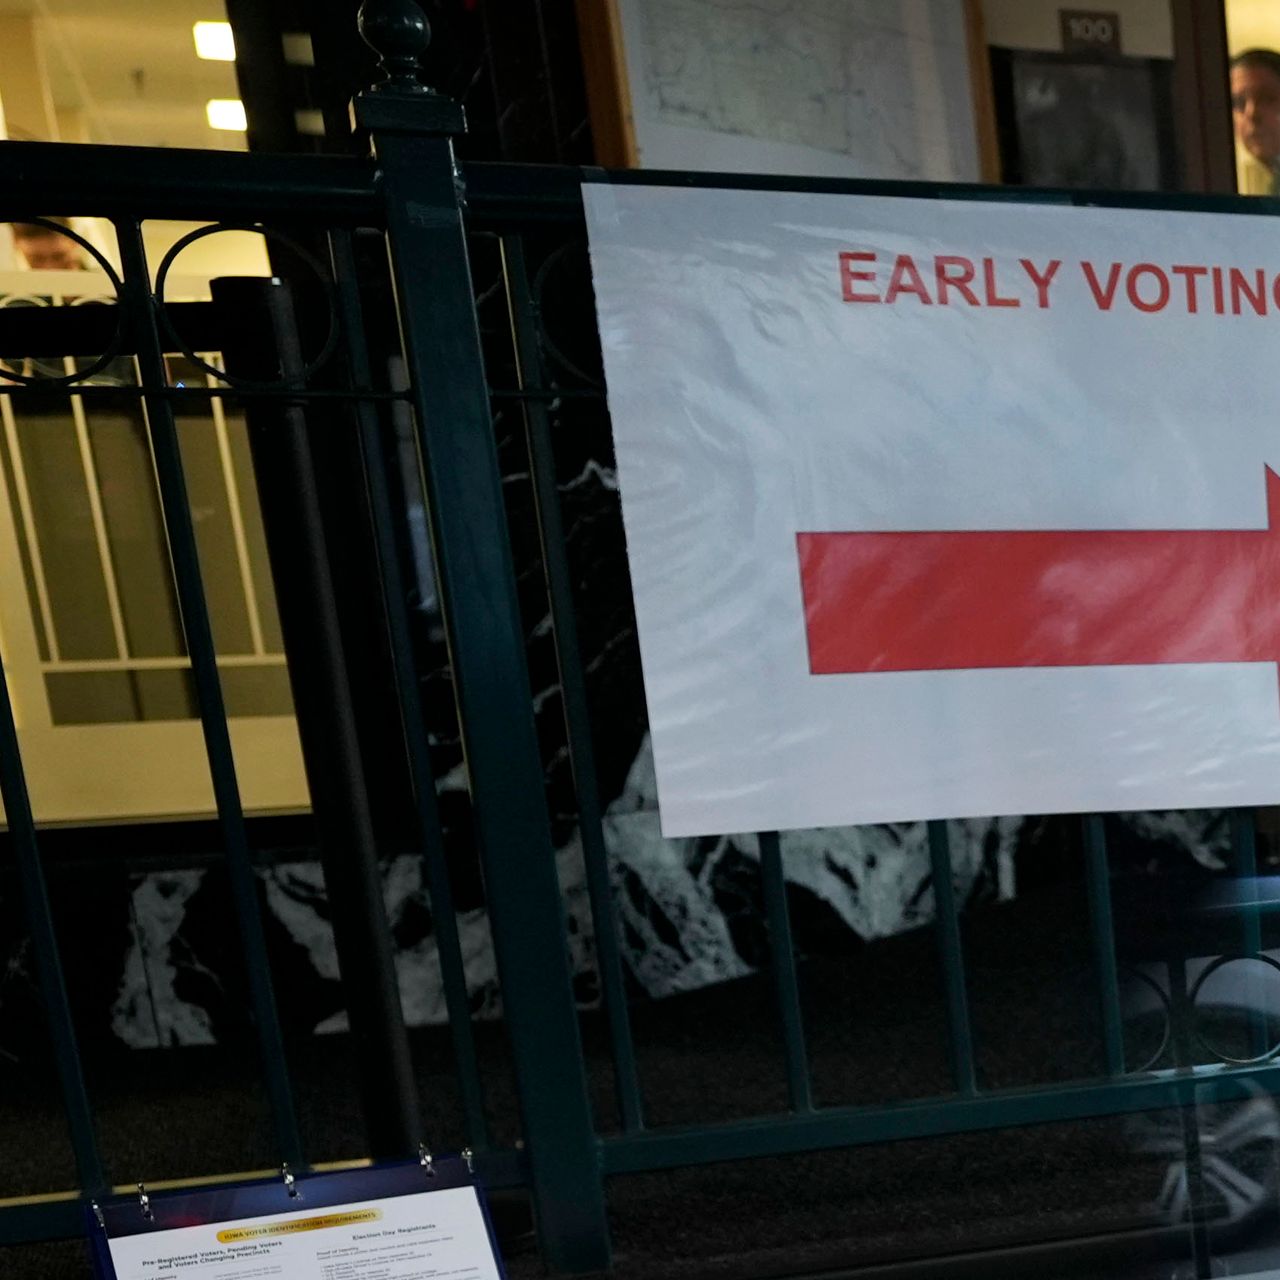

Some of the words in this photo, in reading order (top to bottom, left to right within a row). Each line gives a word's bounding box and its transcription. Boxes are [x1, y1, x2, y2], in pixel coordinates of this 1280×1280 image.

[1069, 17, 1113, 43] 100
[838, 250, 1062, 309] EARLY
[224, 1232, 244, 1240] IOWA
[246, 1228, 267, 1236] VOTER
[352, 1231, 380, 1240] Election
[382, 1229, 396, 1238] Day
[398, 1223, 436, 1234] Registrants
[142, 1253, 198, 1266] Pre-Registered
[200, 1249, 226, 1258] Voters,
[228, 1245, 257, 1254] Pending
[259, 1240, 282, 1249] Voters
[174, 1260, 198, 1268] Voters
[200, 1254, 235, 1265] Changing
[236, 1248, 270, 1258] Precincts
